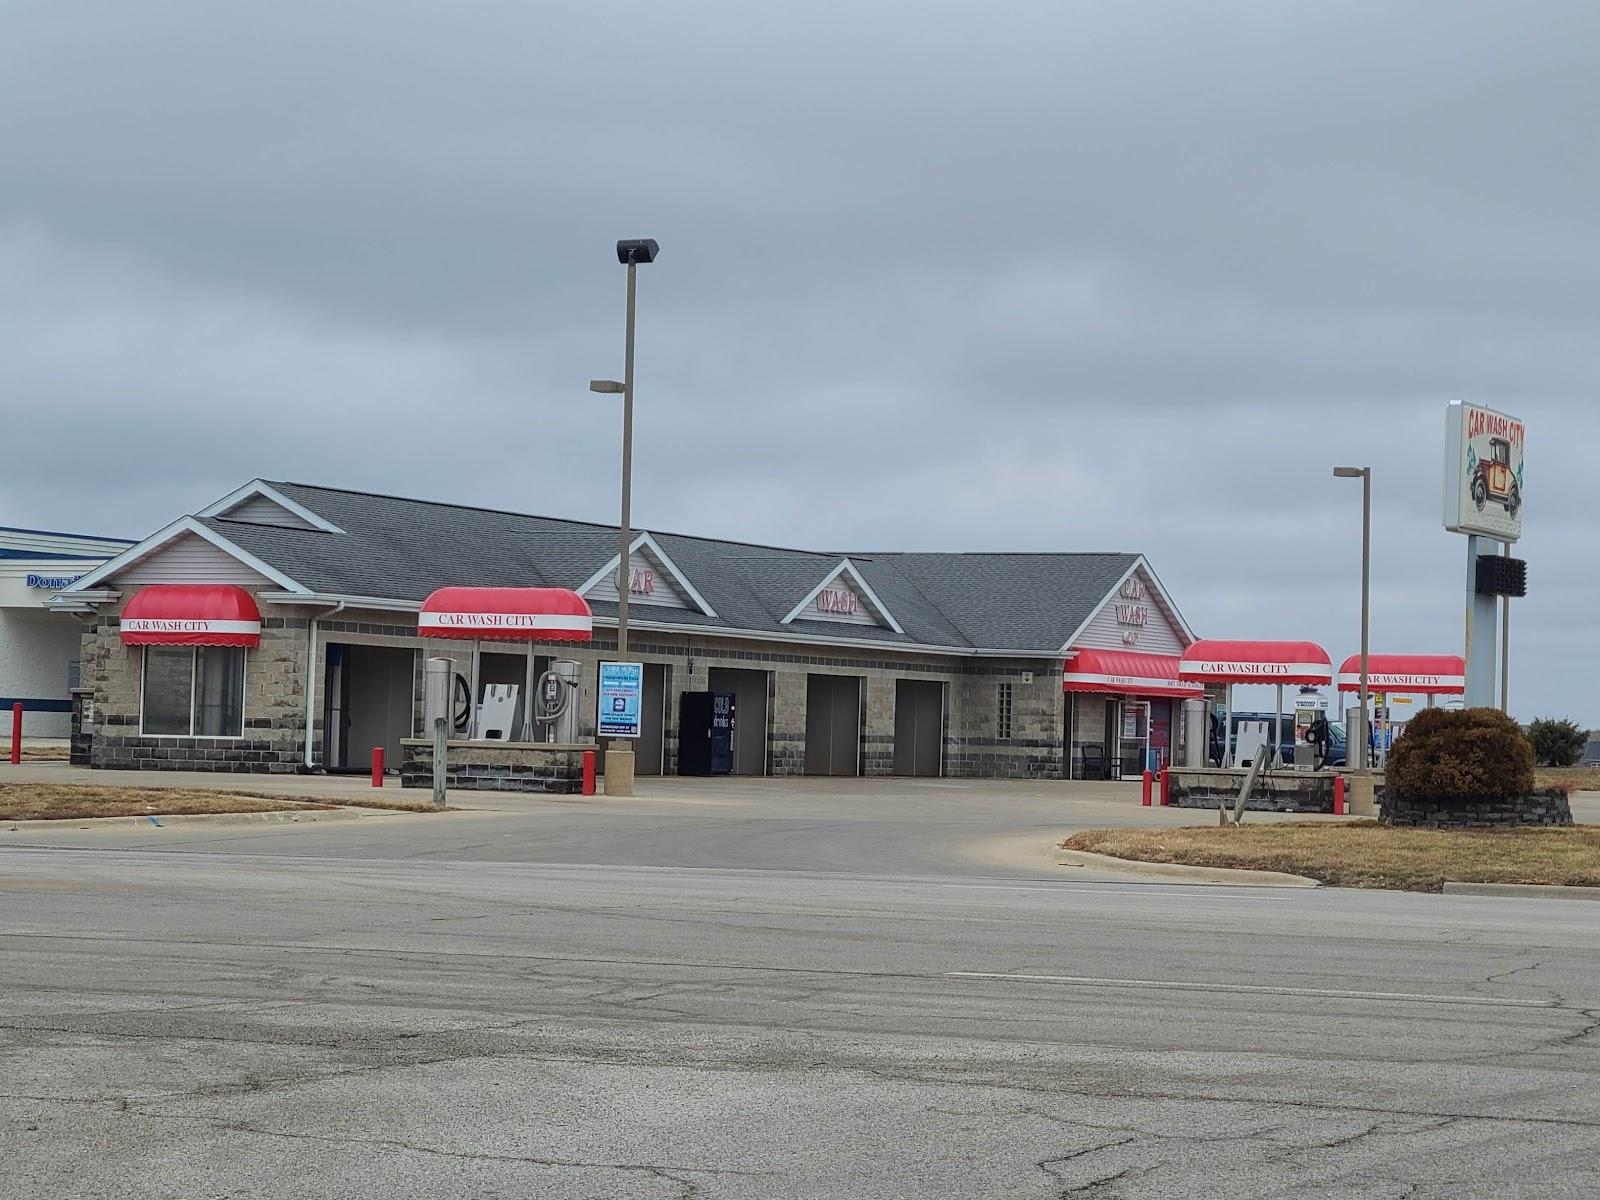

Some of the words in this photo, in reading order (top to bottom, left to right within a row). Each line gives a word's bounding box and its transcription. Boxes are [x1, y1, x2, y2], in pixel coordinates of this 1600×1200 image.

[1468, 408, 1484, 440] CAR
[1487, 413, 1508, 438] WASH
[1509, 421, 1525, 448] CITY
[614, 568, 654, 594] AR
[1120, 579, 1145, 600] CAR
[817, 589, 858, 614] WASH
[439, 614, 464, 625] CAR
[468, 614, 502, 626] WASH
[506, 615, 536, 627] CITY
[1116, 604, 1148, 626] WASH
[128, 620, 149, 630] CAR
[152, 621, 181, 631] WASH
[184, 621, 211, 631] CITY
[1201, 663, 1224, 673] CAR
[1227, 664, 1259, 674] WASH
[1262, 665, 1291, 675] CITY
[1359, 675, 1380, 684] AR
[1382, 675, 1412, 685] WASH
[1415, 676, 1440, 686] CITY
[714, 697, 730, 715] COLD
[713, 714, 729, 727] drinks
